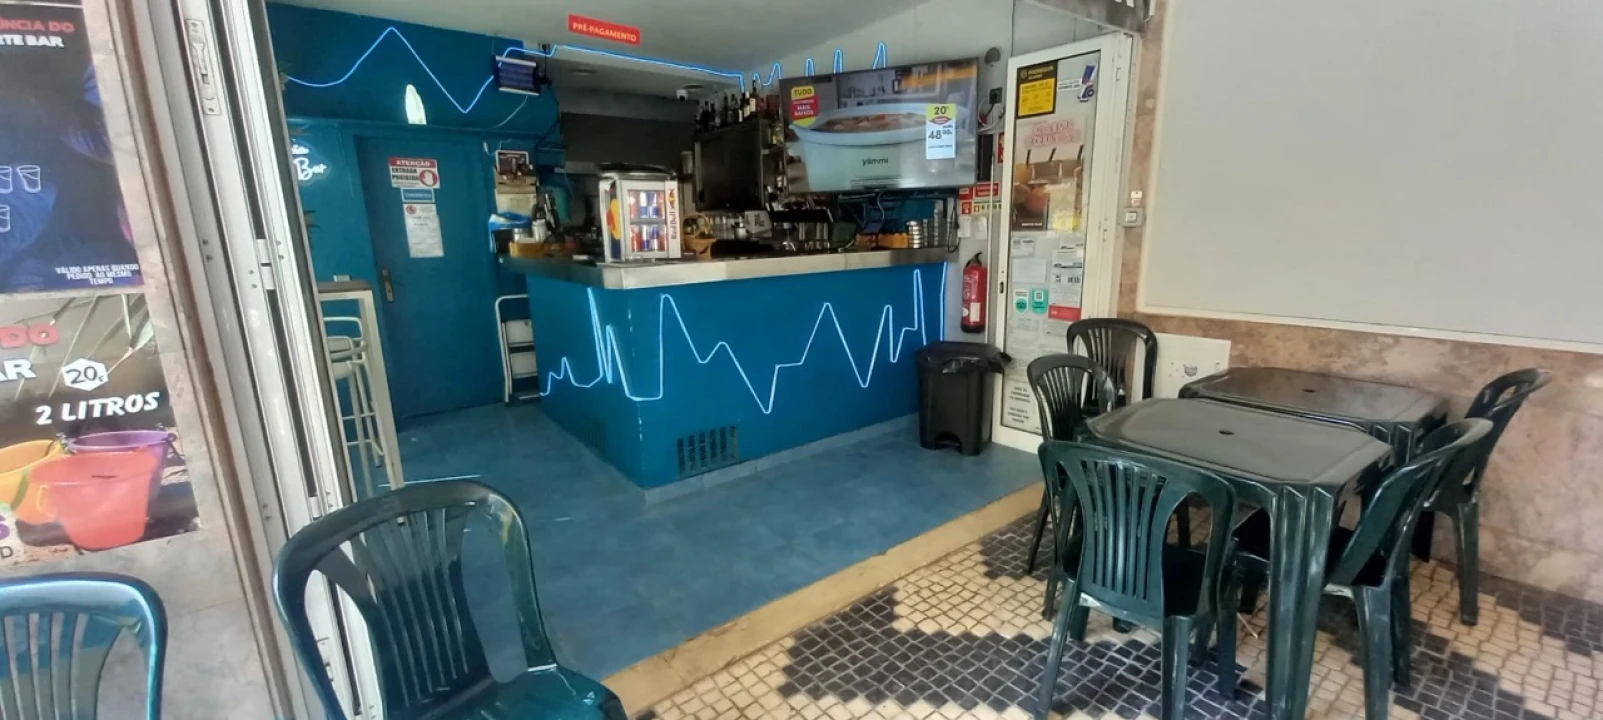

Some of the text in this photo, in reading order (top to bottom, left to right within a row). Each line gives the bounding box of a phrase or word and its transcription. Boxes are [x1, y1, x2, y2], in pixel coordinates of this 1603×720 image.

[48, 21, 75, 33] DO
[572, 22, 637, 42] PRÉ-PAGAMENTO
[25, 34, 65, 48] BAR
[793, 88, 813, 97] TUDO
[395, 158, 431, 169] ATENÇÃO
[35, 391, 160, 425] 2 LITROS
